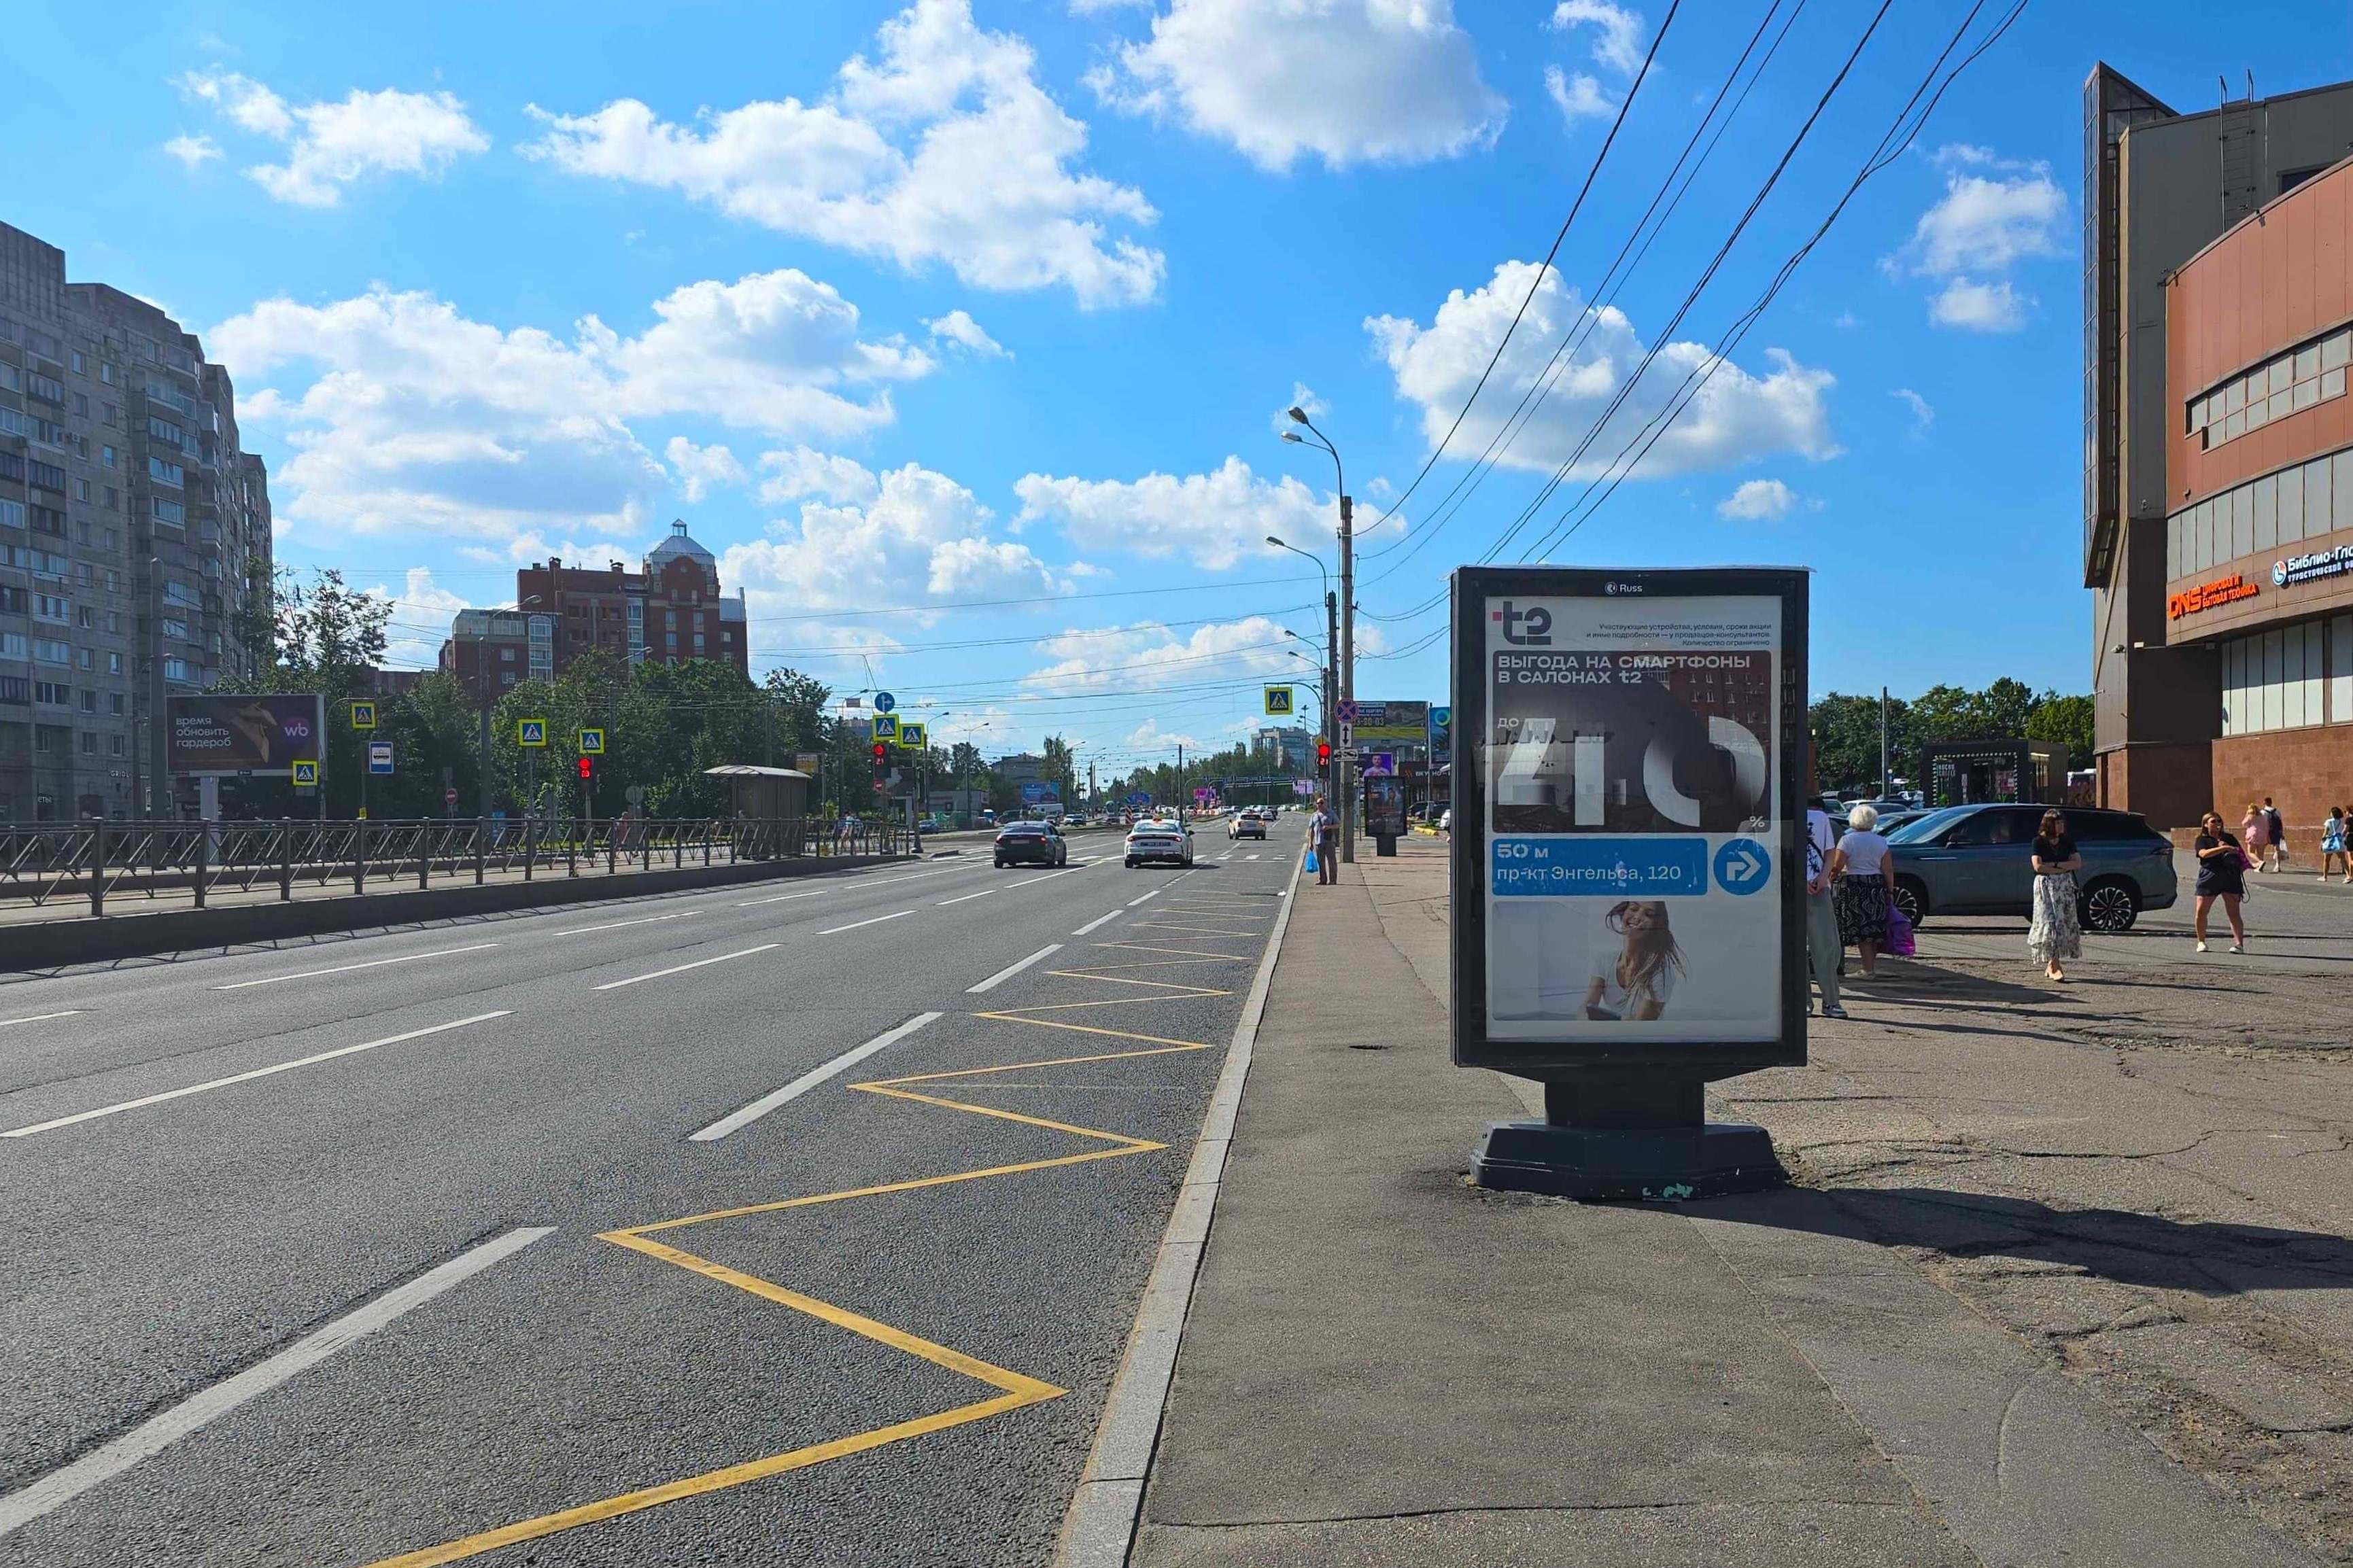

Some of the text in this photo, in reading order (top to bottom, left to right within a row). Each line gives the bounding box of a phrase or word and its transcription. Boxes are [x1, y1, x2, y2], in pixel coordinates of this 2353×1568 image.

[1619, 584, 1643, 592] Russ
[2167, 586, 2201, 621] DNS
[1493, 602, 1551, 645] t2
[1498, 656, 1750, 670] ВЫГОДА НА СМАРТФОНЫ
[1498, 670, 1642, 684] В САЛОНАХ t2
[176, 718, 211, 727] время
[176, 727, 229, 736] обновить
[285, 723, 309, 737] wb
[177, 737, 231, 748] гардероб
[1498, 843, 1528, 858] 50
[1497, 866, 1681, 883] пр-кт Энгельса, 120
